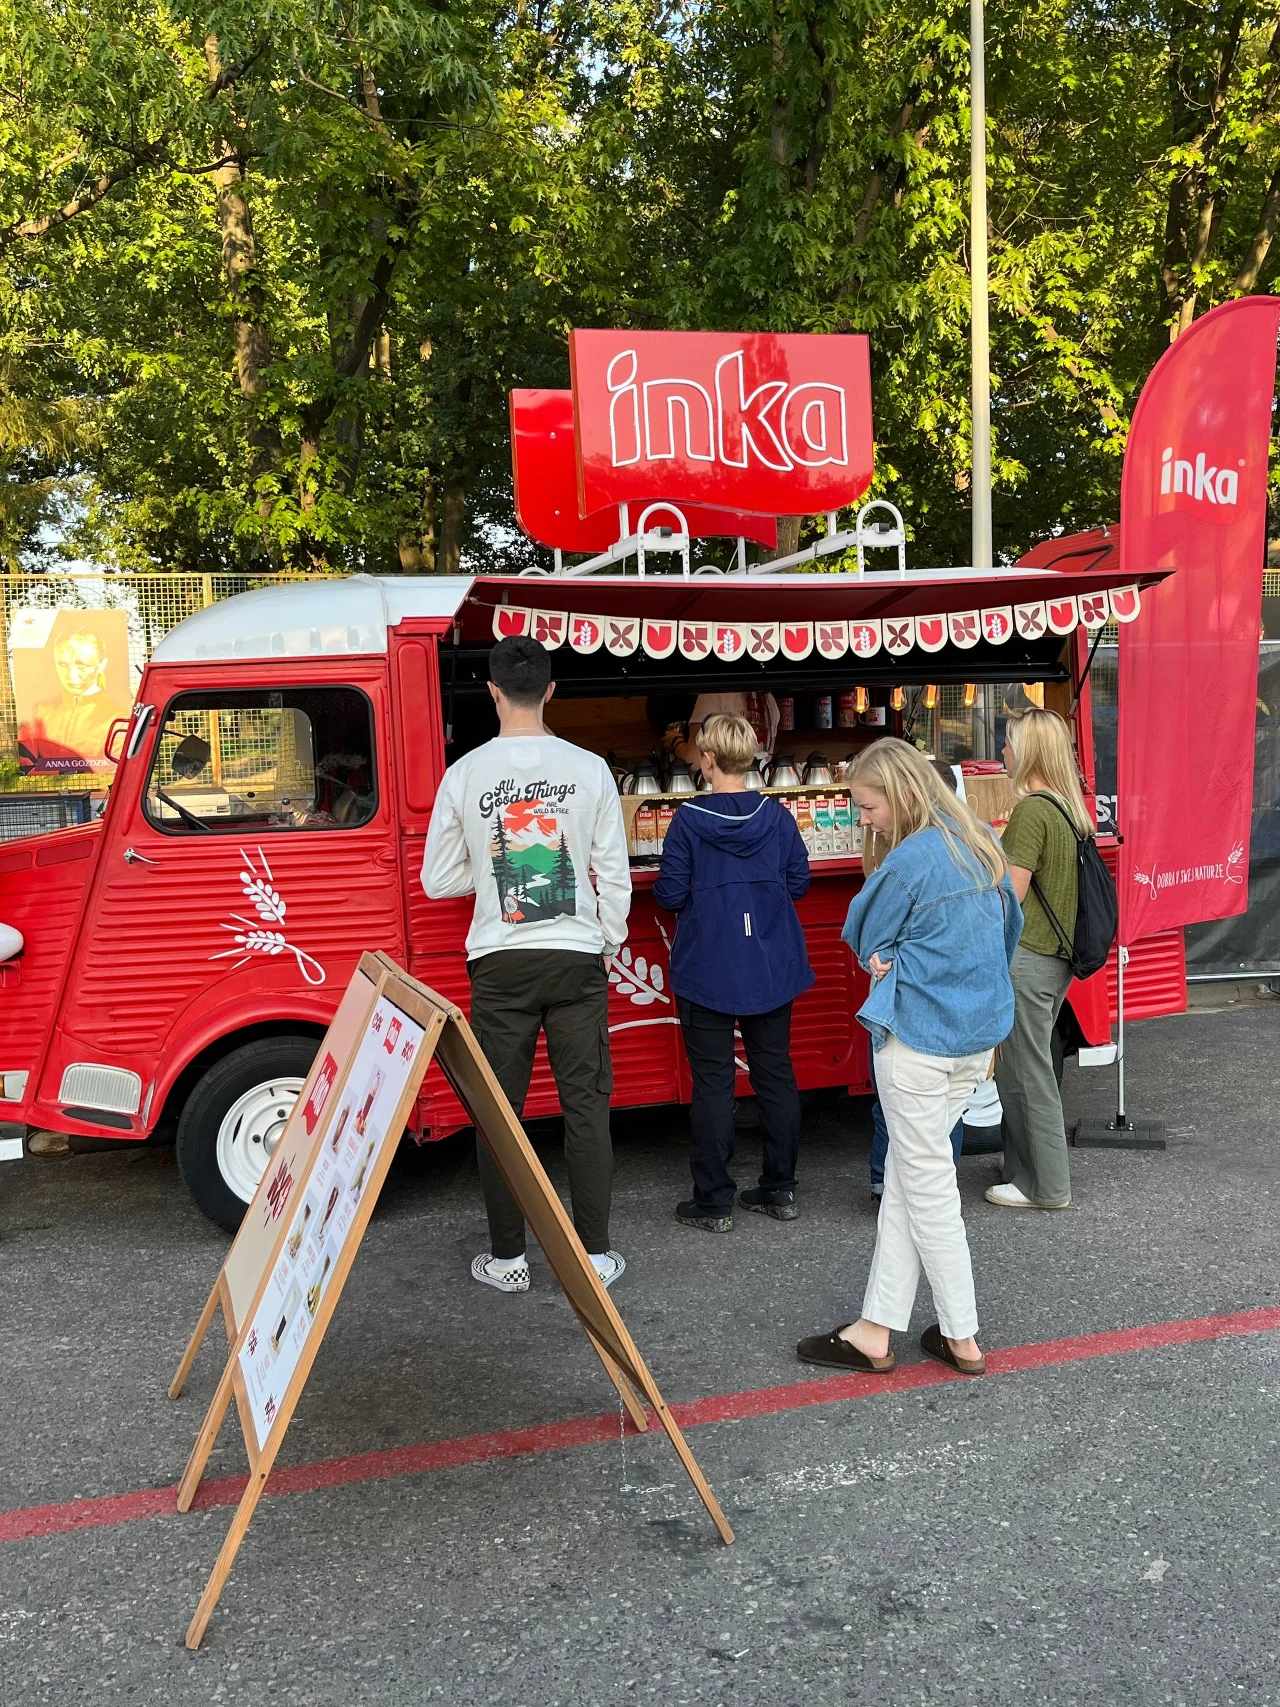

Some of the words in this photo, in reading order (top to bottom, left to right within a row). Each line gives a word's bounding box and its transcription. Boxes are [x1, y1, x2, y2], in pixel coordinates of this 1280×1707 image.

[607, 350, 848, 472] inka
[1161, 447, 1239, 505] inka
[45, 760, 71, 768] ANNA
[479, 788, 522, 818] Good
[525, 779, 577, 802] Things
[494, 779, 515, 797] All
[1195, 864, 1224, 880] NATURZE
